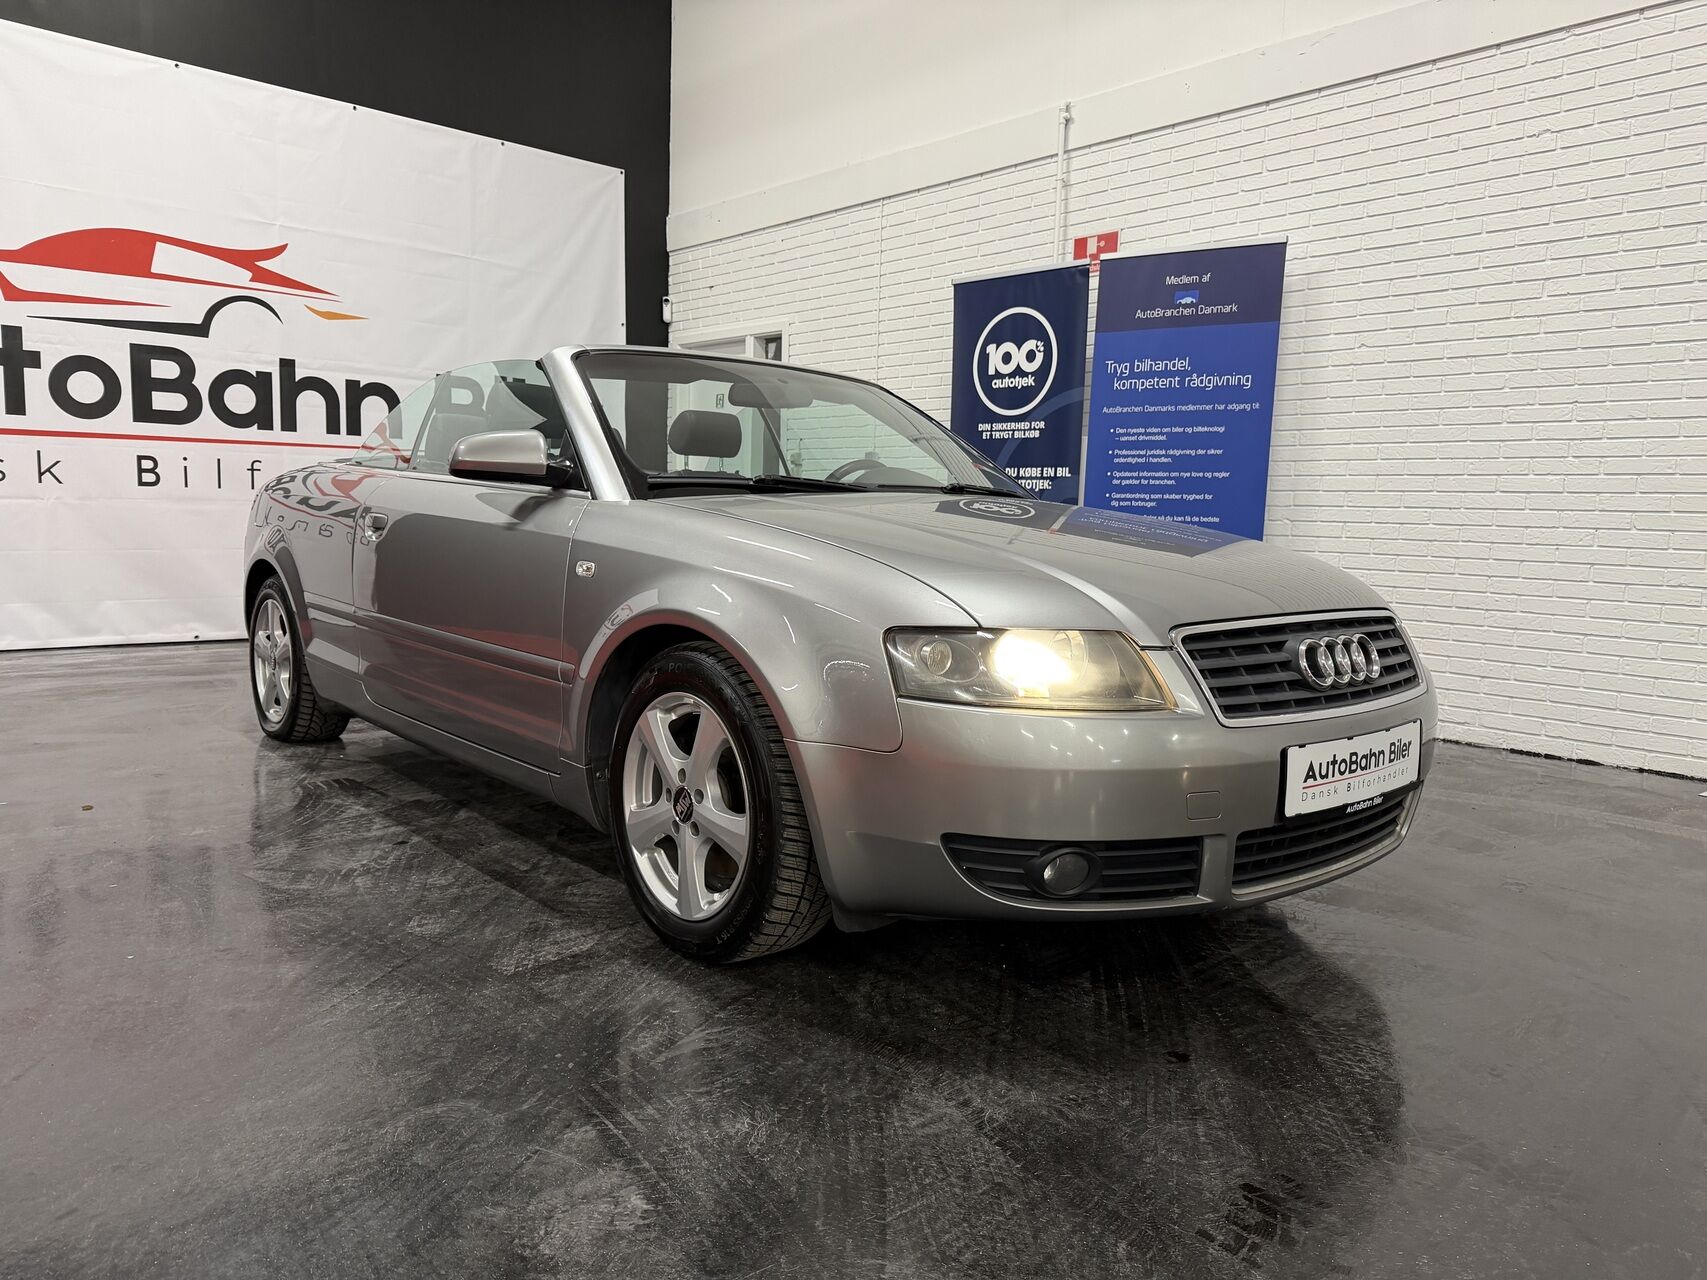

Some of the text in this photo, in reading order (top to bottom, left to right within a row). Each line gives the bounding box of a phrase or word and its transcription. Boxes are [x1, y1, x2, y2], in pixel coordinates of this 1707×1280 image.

[1165, 272, 1211, 285] Medlem af
[1135, 303, 1238, 319] AutoBranchen Danmark
[1105, 357, 1191, 376] Tryg bilhandel,
[992, 374, 1035, 389] autotjek
[1113, 372, 1252, 392] kompetent rådgivning
[1102, 406, 1143, 414] AutoBranchen
[1144, 404, 1176, 413] Danmarks
[1177, 403, 1213, 412] medlemmer
[1214, 403, 1226, 411] har
[1226, 402, 1251, 412] adgang
[978, 420, 1045, 431] DIN SIKKERHED FOR
[982, 430, 1040, 439] ET TRYGT BILKØB
[1166, 448, 1196, 456] rådgivning
[1019, 467, 1042, 477] KØBE
[1043, 467, 1055, 477] EN
[1056, 466, 1072, 477] BIL
[1180, 471, 1191, 479] nye
[1204, 471, 1213, 479] og
[1212, 471, 1230, 479] regler
[1121, 478, 1140, 486] gælder
[1149, 478, 1177, 486] branchen.
[1182, 493, 1204, 501] tryghed
[1302, 738, 1413, 784] AutoBahn Biler
[1301, 766, 1409, 802] Dansk Bilforhandler
[1346, 795, 1384, 814] AutoBahn Biler
